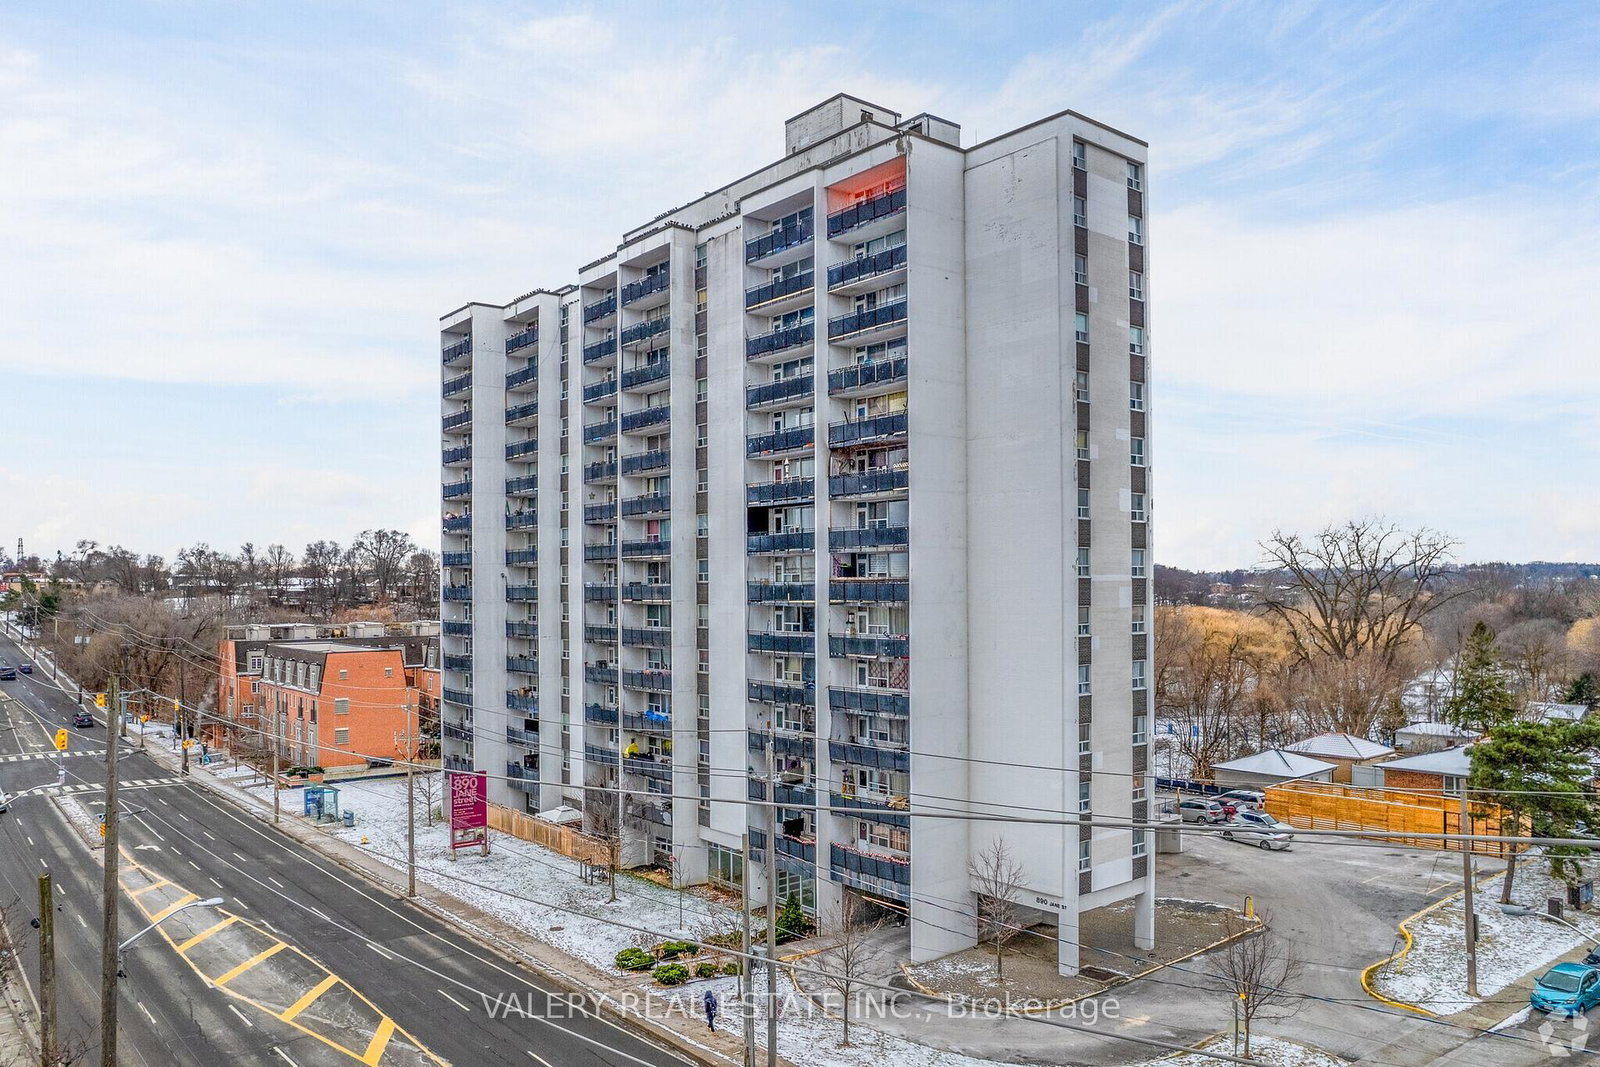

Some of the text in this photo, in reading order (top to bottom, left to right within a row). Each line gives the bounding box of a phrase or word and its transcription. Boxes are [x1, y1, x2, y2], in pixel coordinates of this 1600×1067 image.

[454, 777, 478, 790] 890
[453, 788, 477, 798] JANE
[453, 796, 477, 804] street
[1036, 897, 1048, 905] 890
